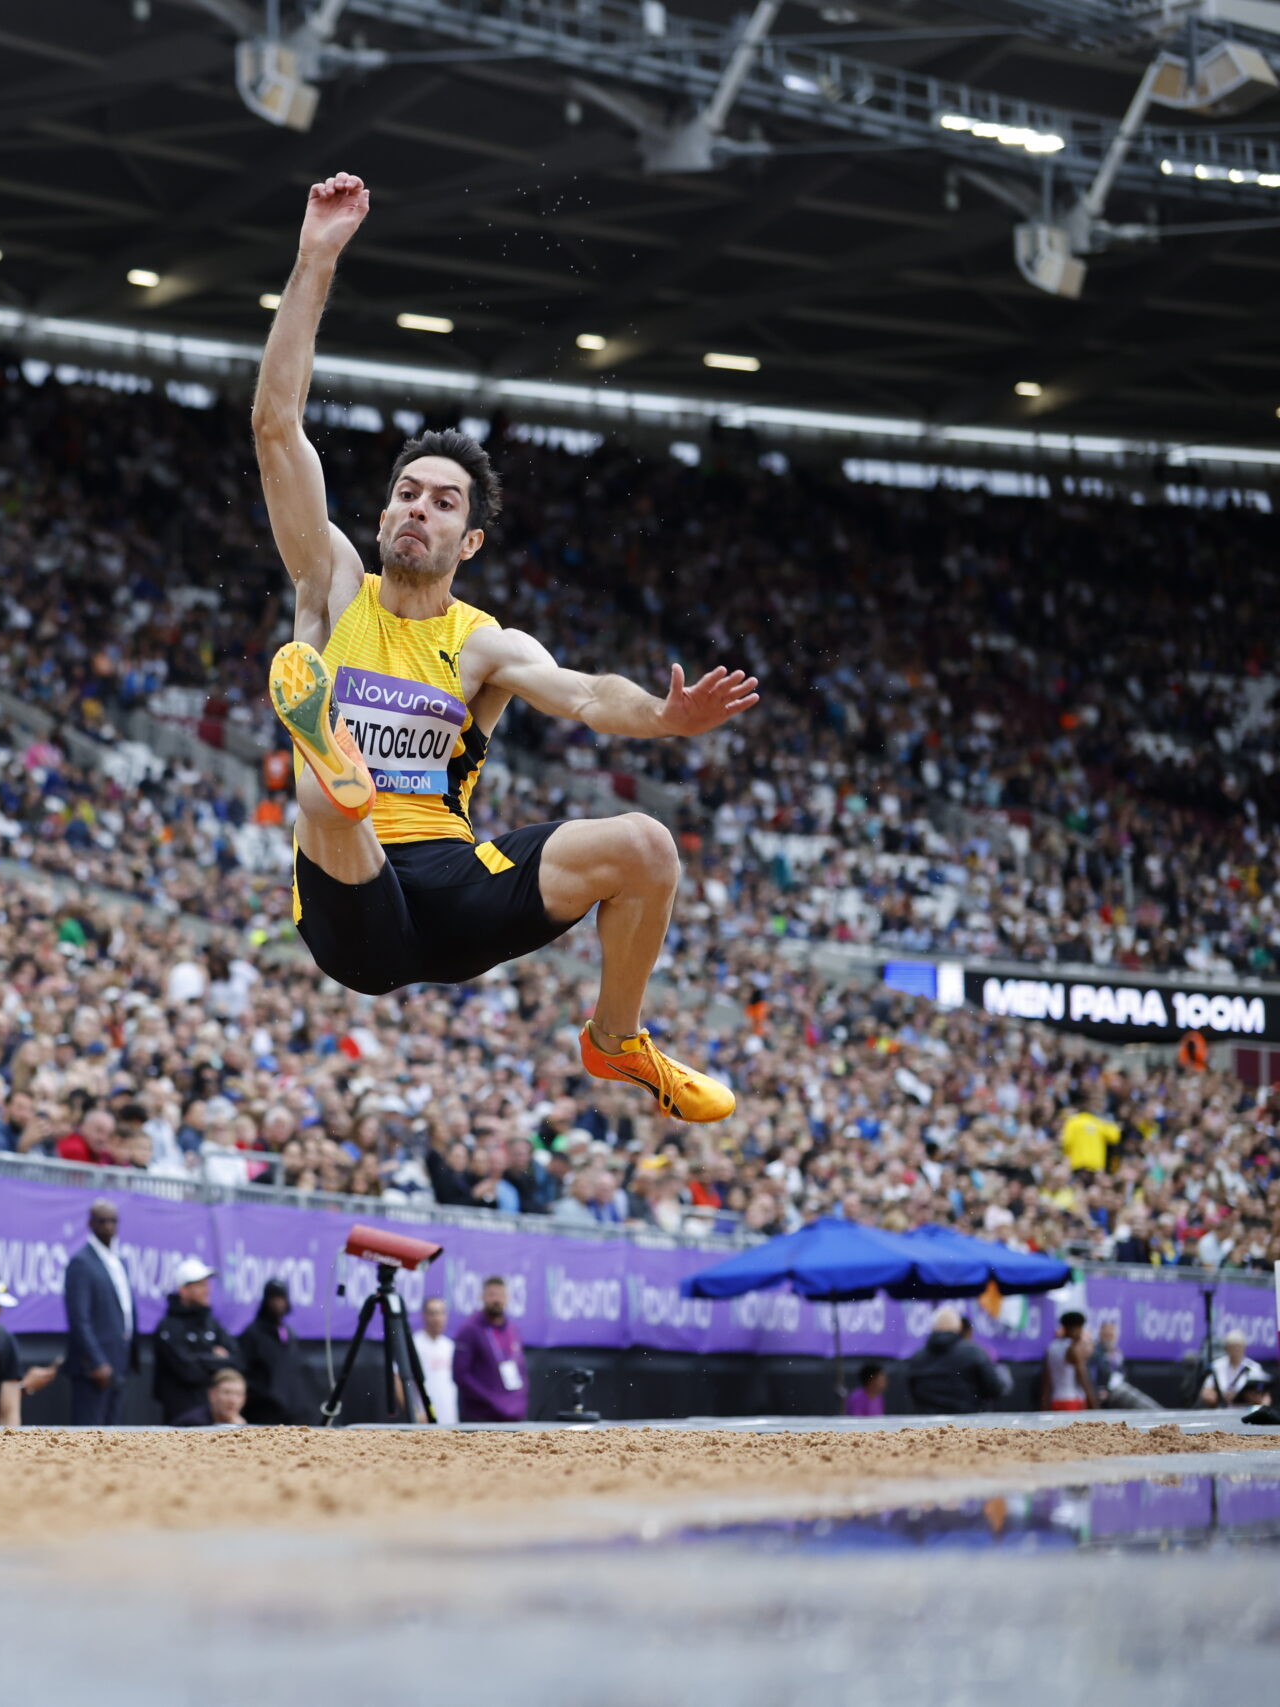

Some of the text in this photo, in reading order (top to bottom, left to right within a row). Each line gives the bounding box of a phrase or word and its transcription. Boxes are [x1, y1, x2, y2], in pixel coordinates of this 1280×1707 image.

[345, 675, 449, 716] Novuna
[344, 718, 451, 760] NTOGLOU
[375, 774, 432, 790] ONDON
[982, 977, 1266, 1034] MEN PARA 100M
